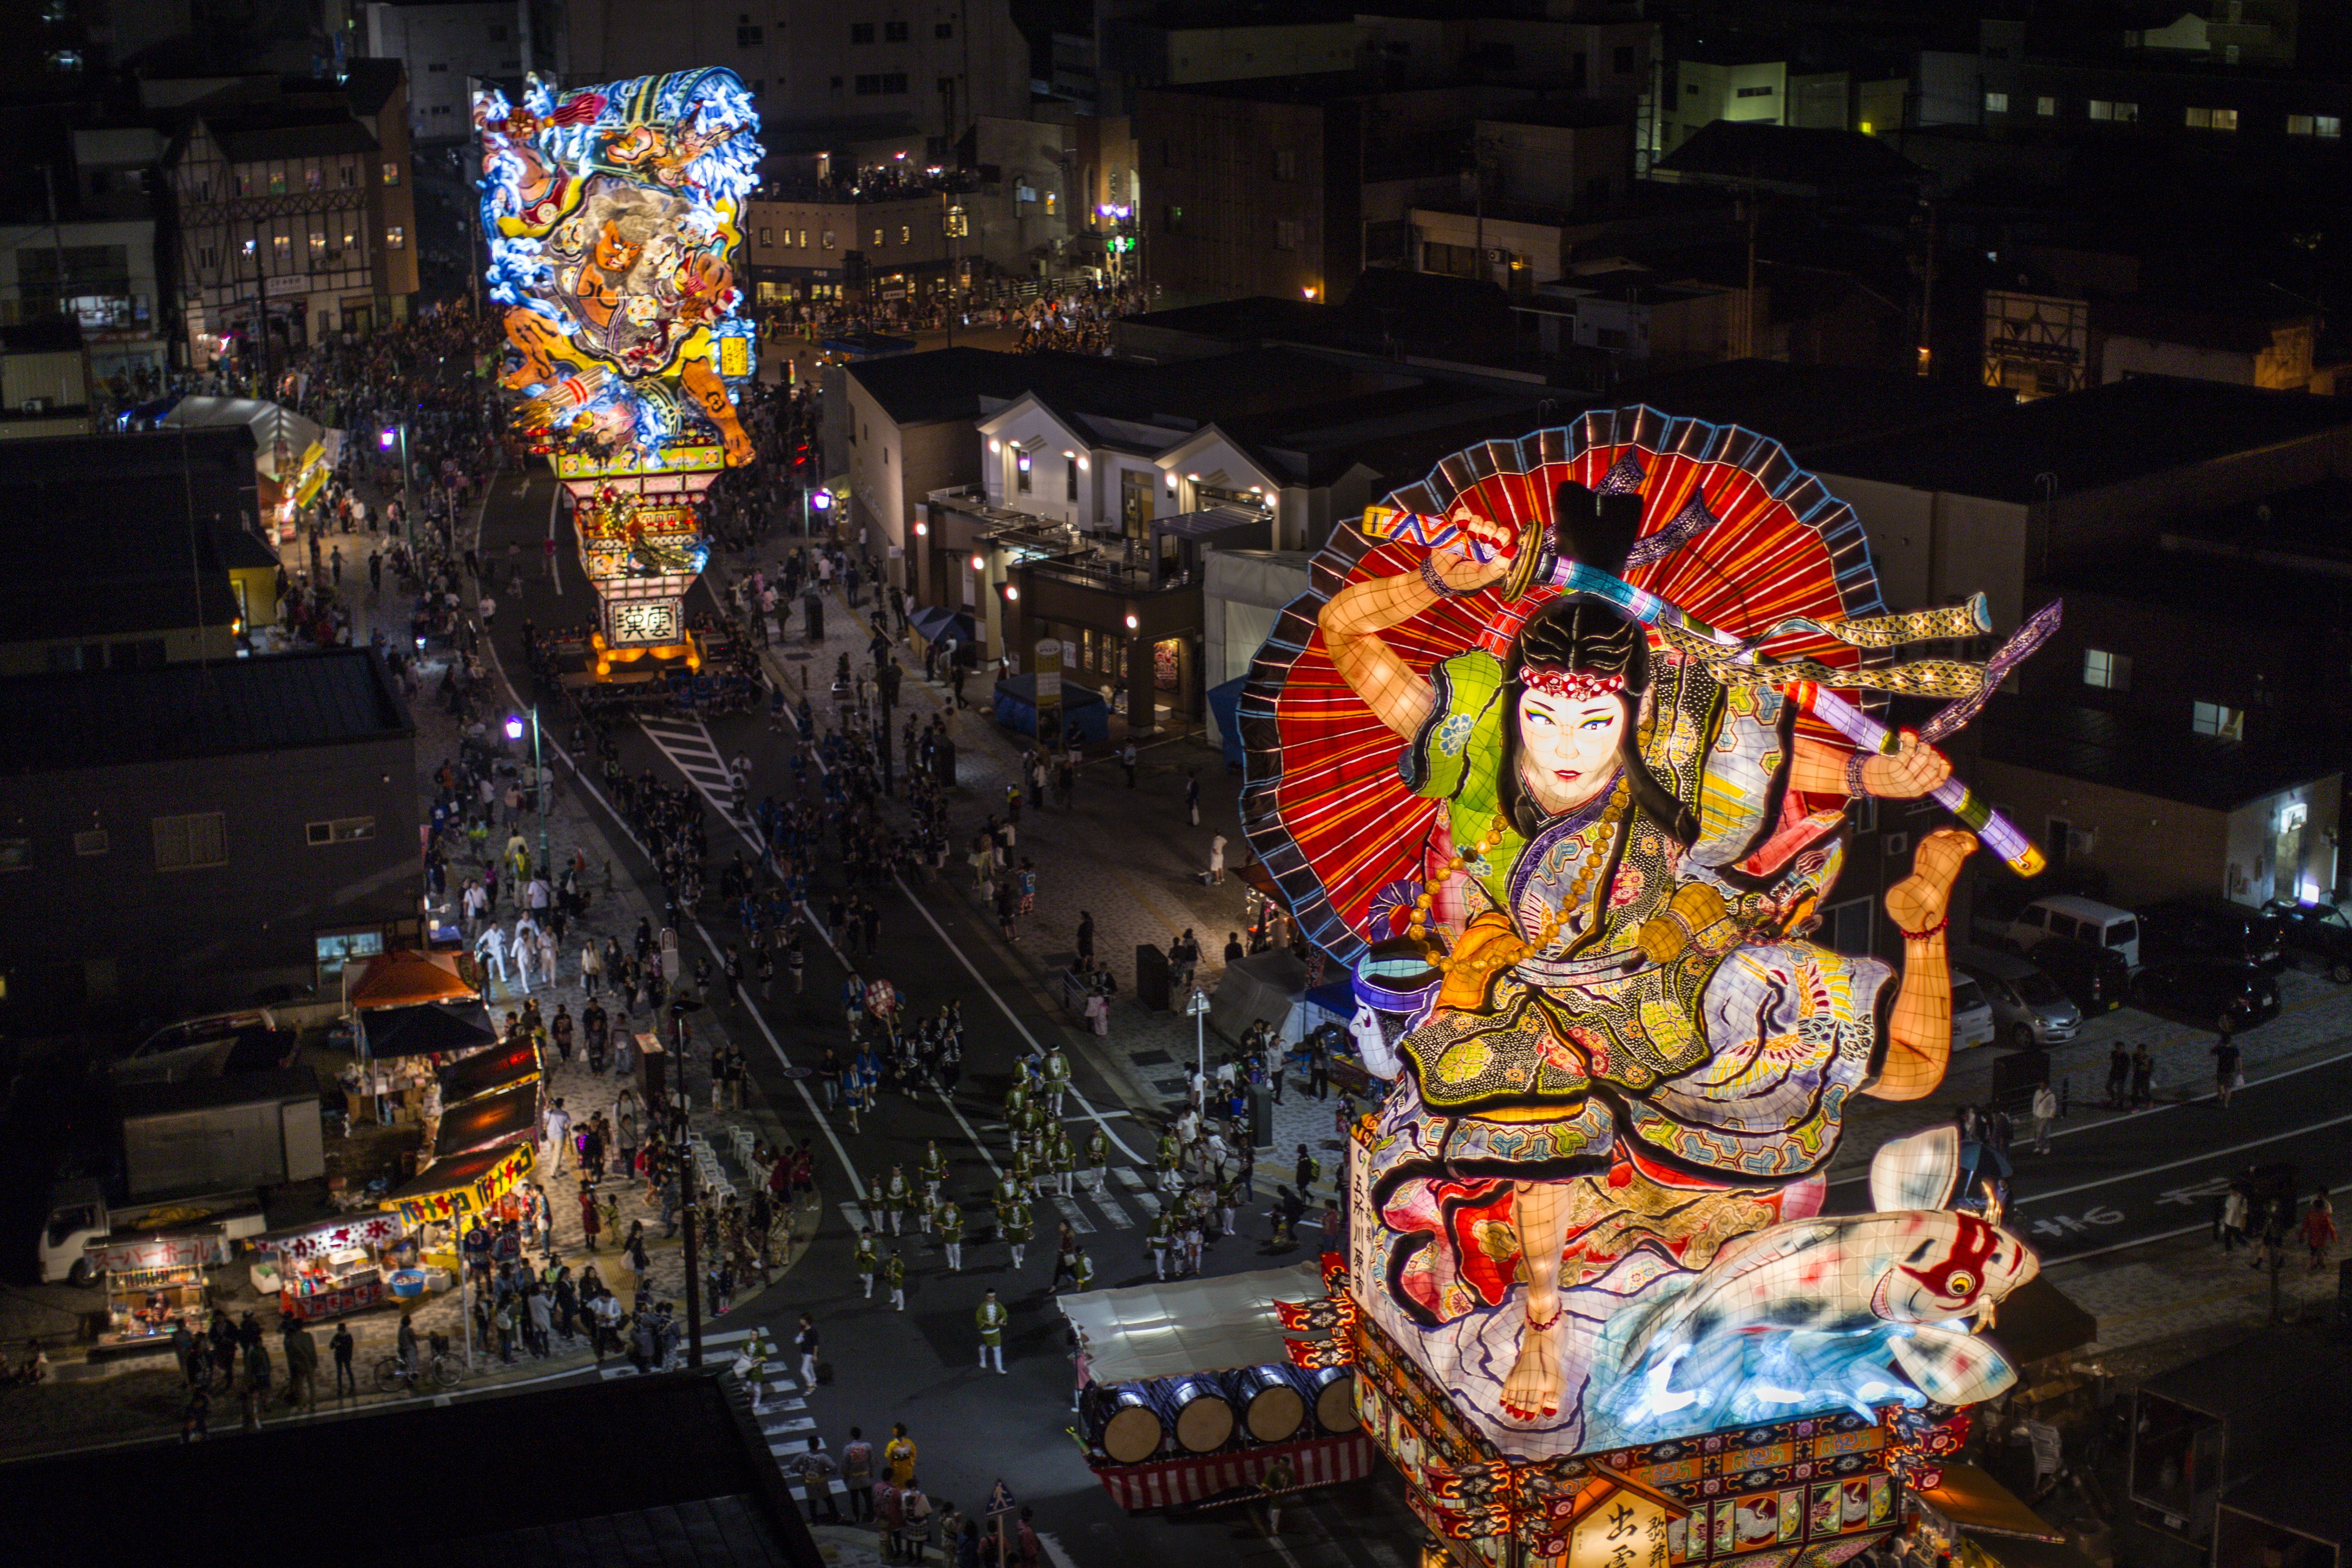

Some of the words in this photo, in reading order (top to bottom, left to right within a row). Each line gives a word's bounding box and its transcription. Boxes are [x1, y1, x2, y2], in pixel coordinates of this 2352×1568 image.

[1353, 1174, 1365, 1298] 五所川原市
